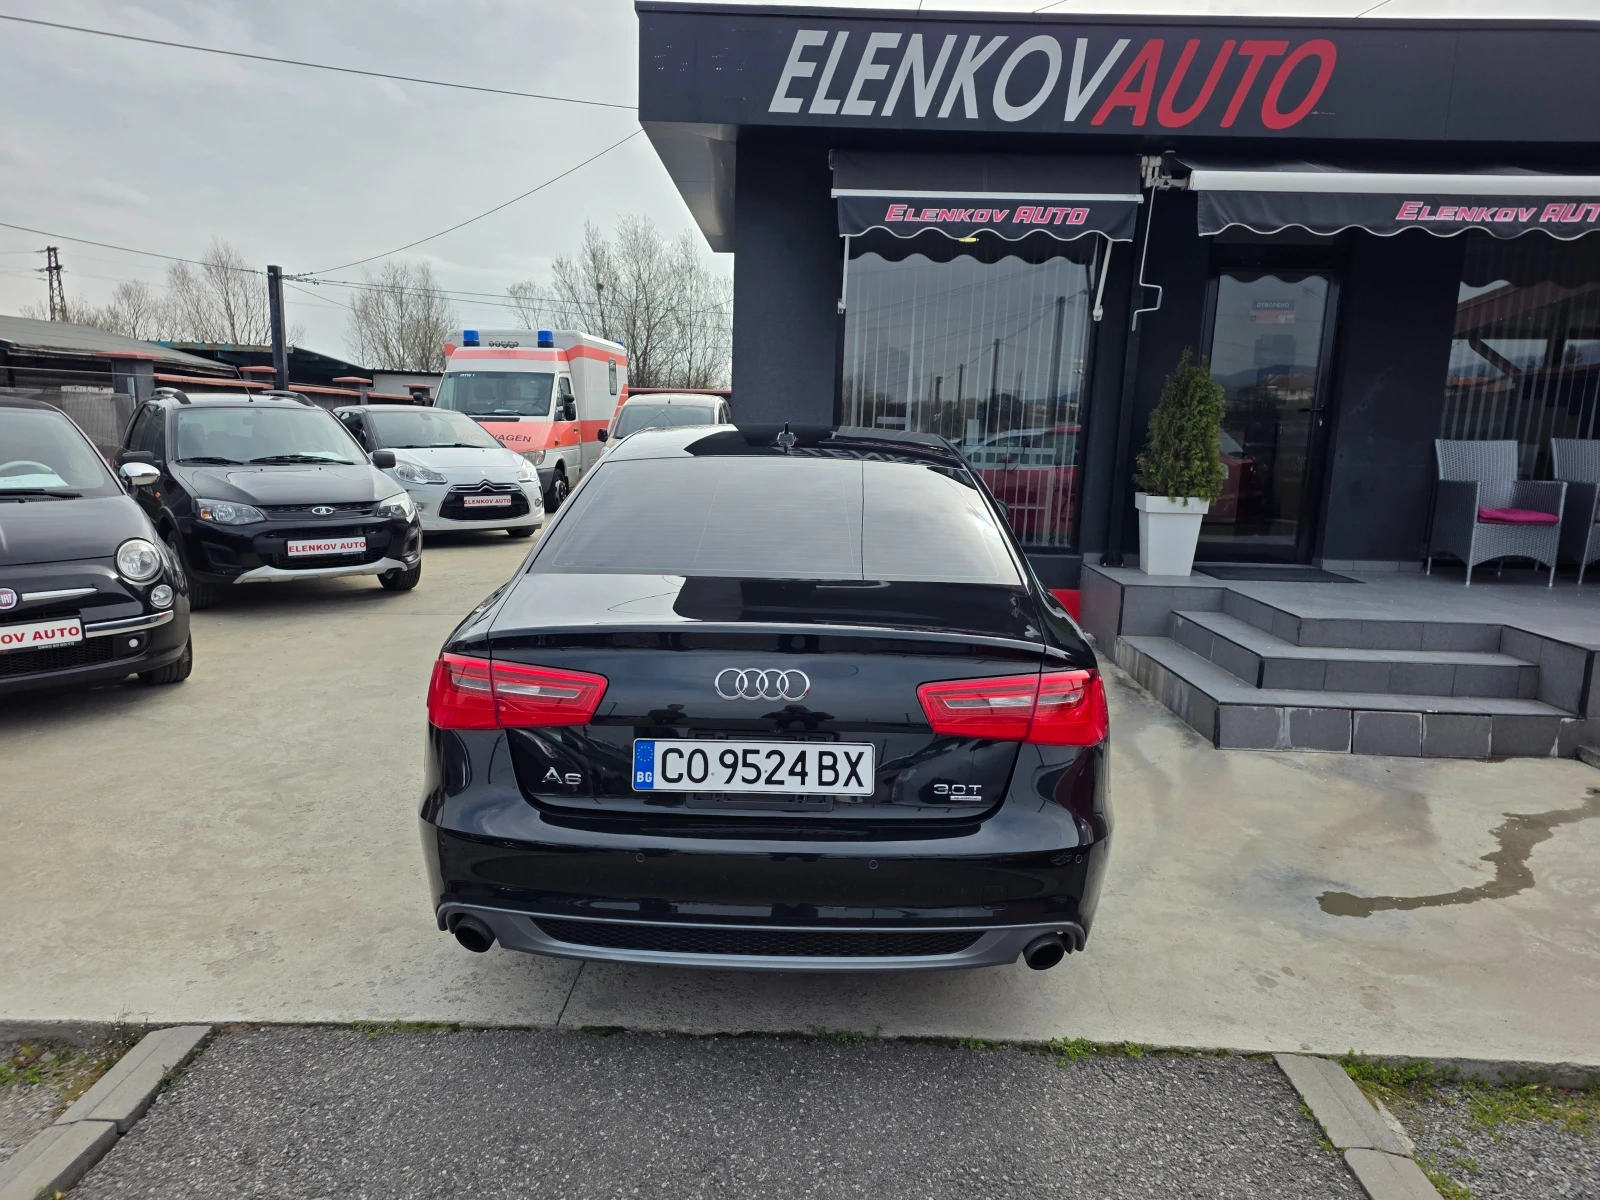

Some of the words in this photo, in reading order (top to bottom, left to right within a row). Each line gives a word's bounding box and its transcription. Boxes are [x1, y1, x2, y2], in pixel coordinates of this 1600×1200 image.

[768, 29, 1131, 122] ELENKOV
[1090, 38, 1337, 129] AUTO
[1013, 206, 1090, 225] AUTO
[1539, 203, 1600, 223] AUT
[288, 543, 337, 553] ELENKOV
[340, 541, 367, 550] AUTO
[32, 626, 80, 641] AUTO
[541, 766, 582, 785] A6
[636, 771, 653, 783] BG
[718, 748, 808, 786] 9524
[818, 750, 865, 788] BX
